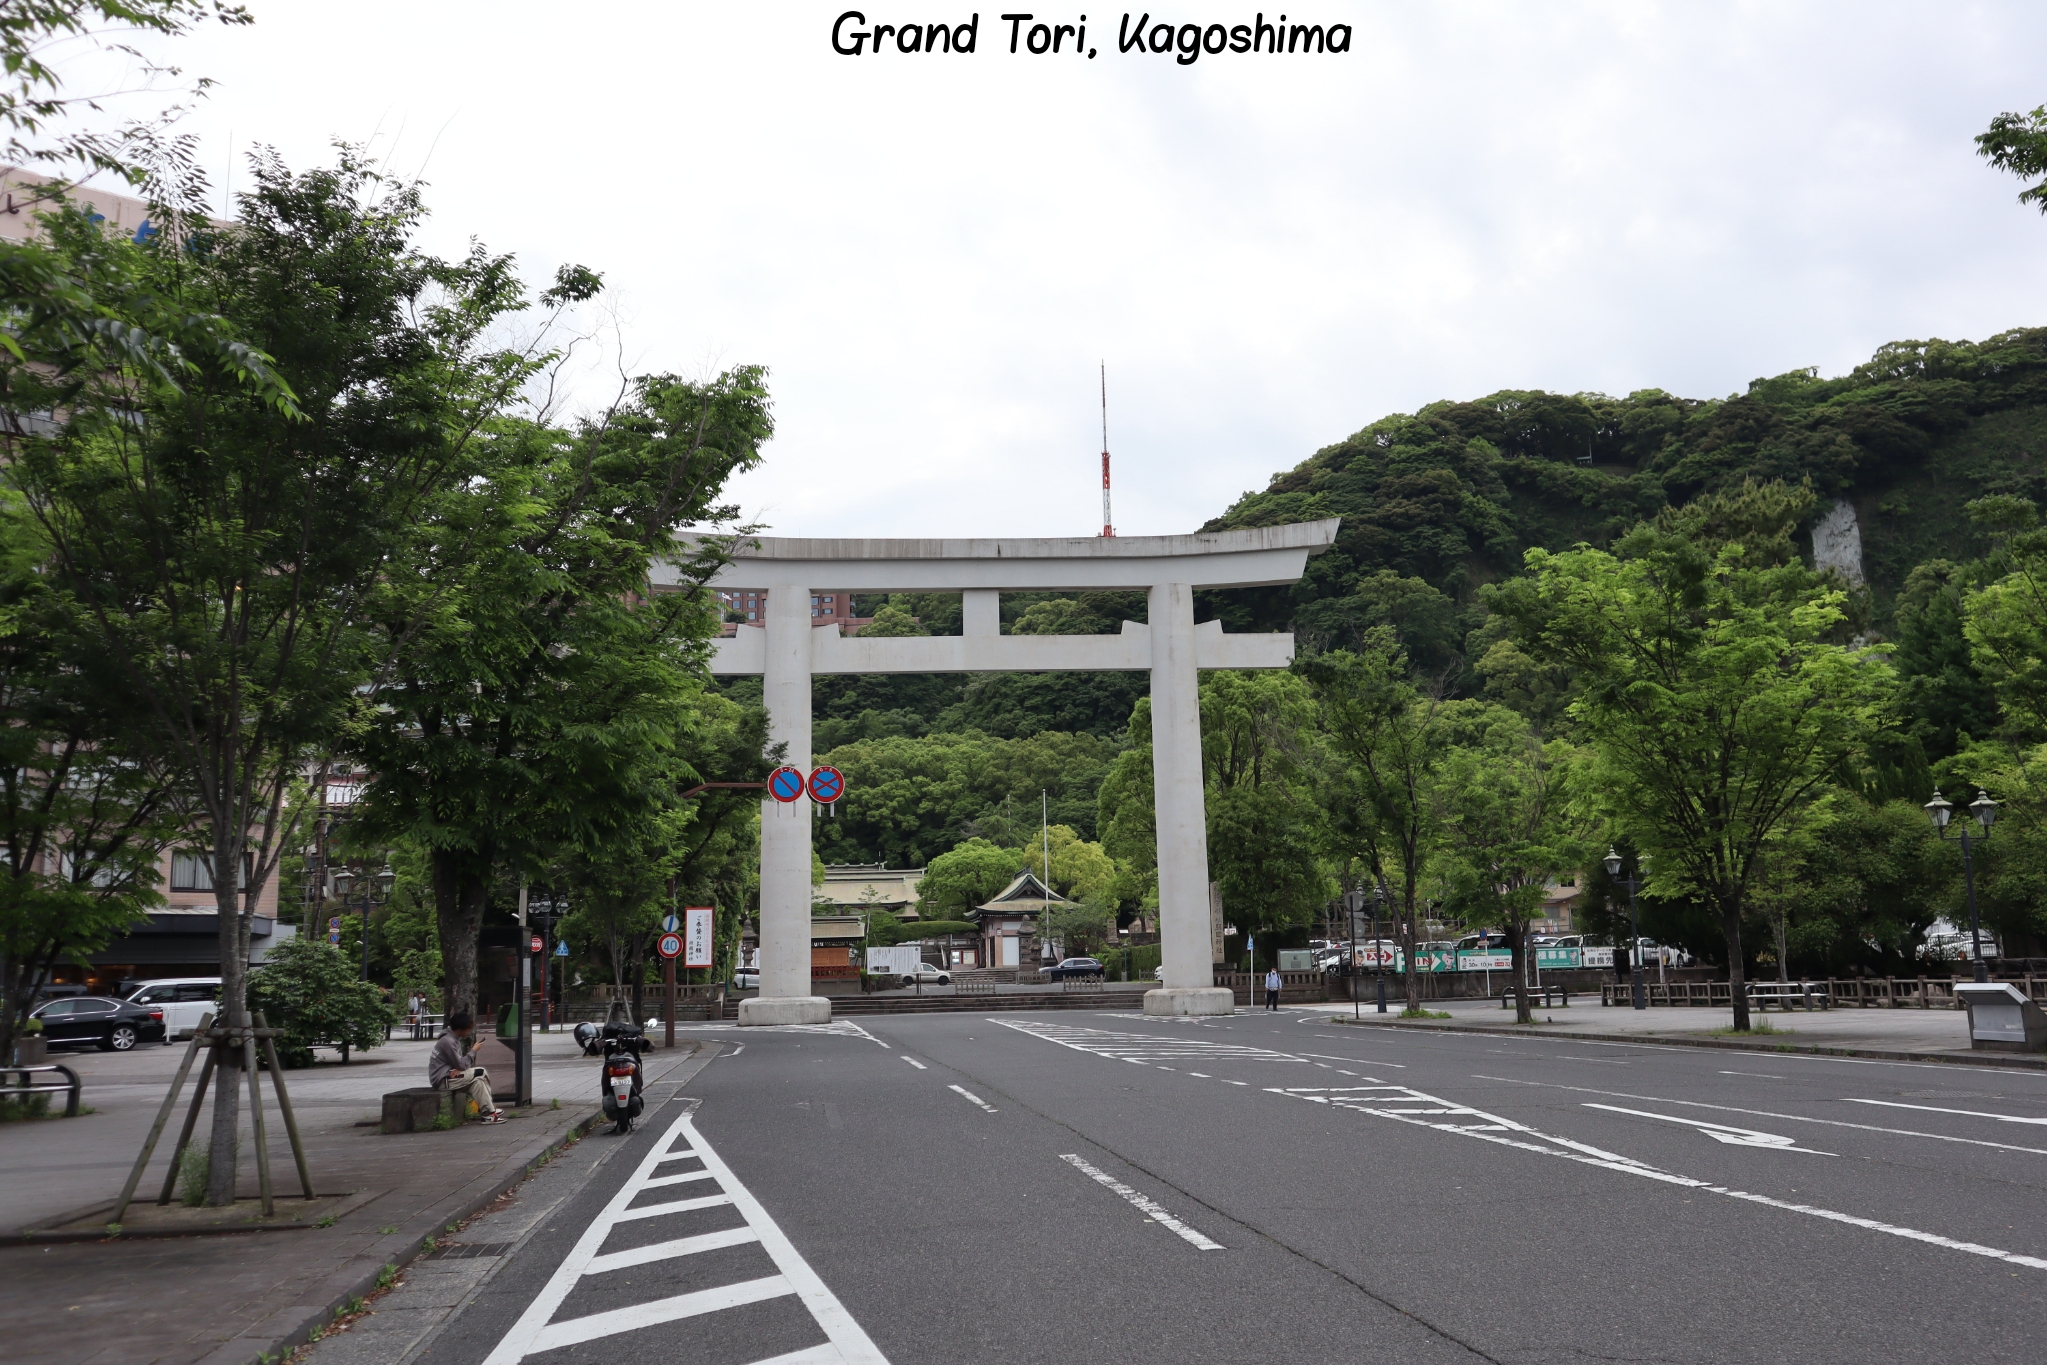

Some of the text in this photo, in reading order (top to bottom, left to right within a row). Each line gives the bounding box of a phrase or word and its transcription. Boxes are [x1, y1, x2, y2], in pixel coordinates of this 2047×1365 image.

[664, 941, 677, 951] 40
[1369, 952, 1387, 960] 入口
[1417, 957, 1433, 965] IN
